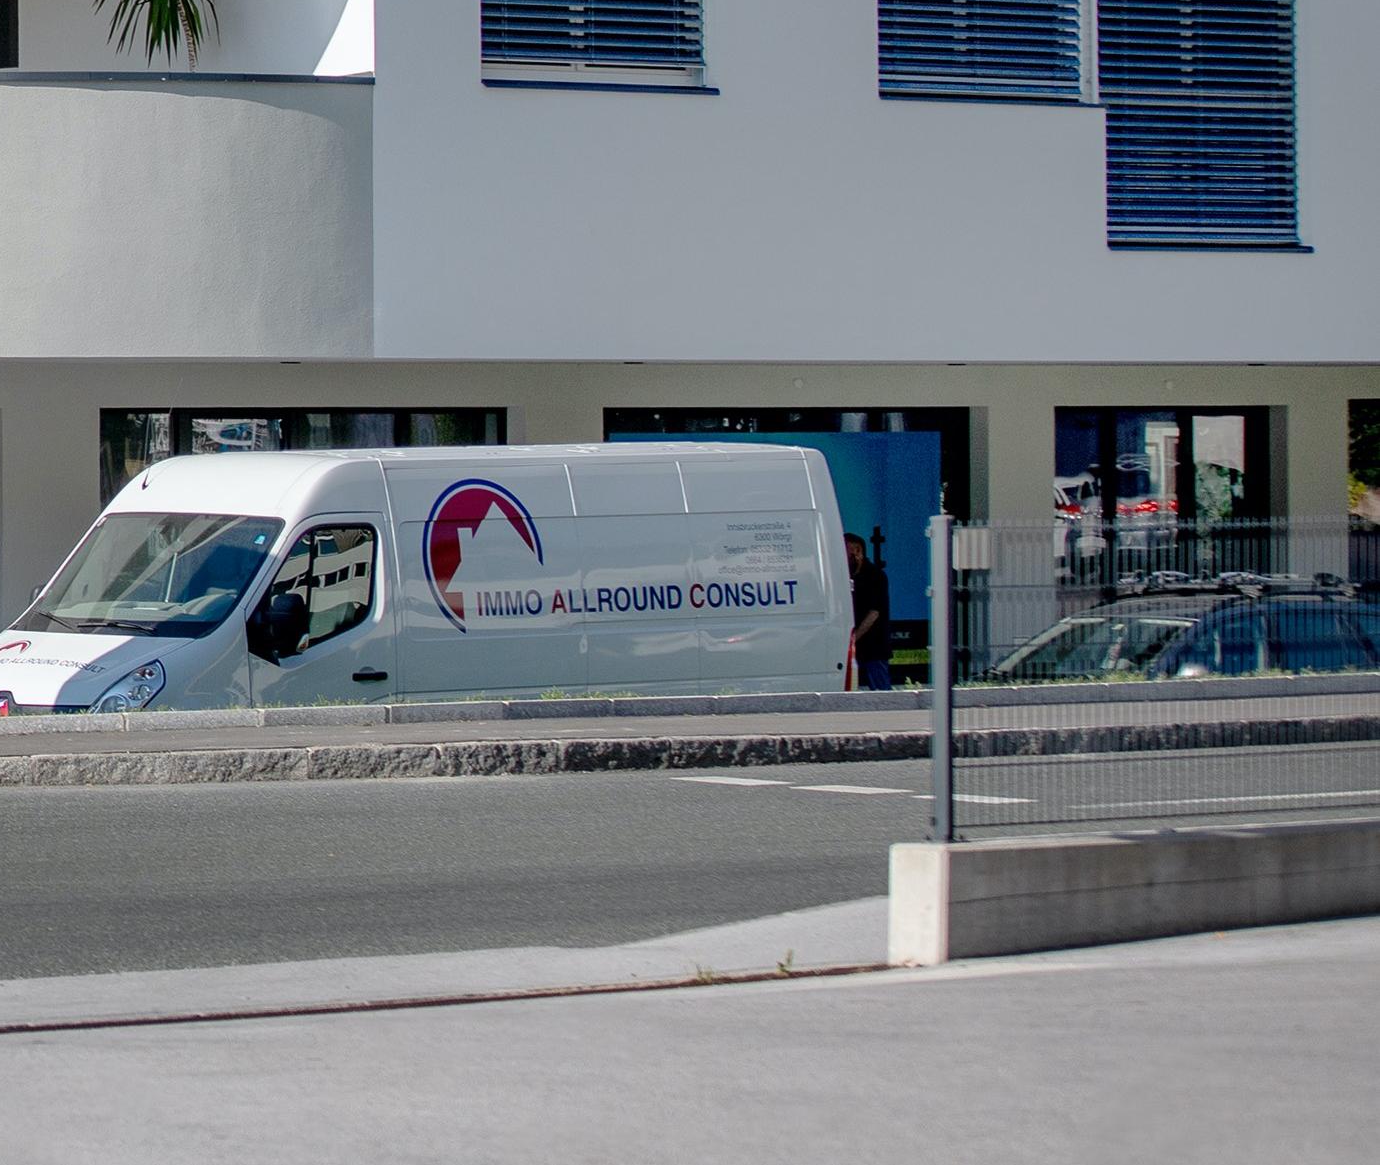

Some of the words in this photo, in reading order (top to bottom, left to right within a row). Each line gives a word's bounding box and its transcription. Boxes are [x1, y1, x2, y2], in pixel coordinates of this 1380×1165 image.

[477, 588, 543, 617] IMMO
[551, 584, 683, 614] ALLROUND
[689, 579, 799, 609] CONSULT
[10, 658, 59, 666] ALLROUND
[59, 660, 106, 673] CONSULT
